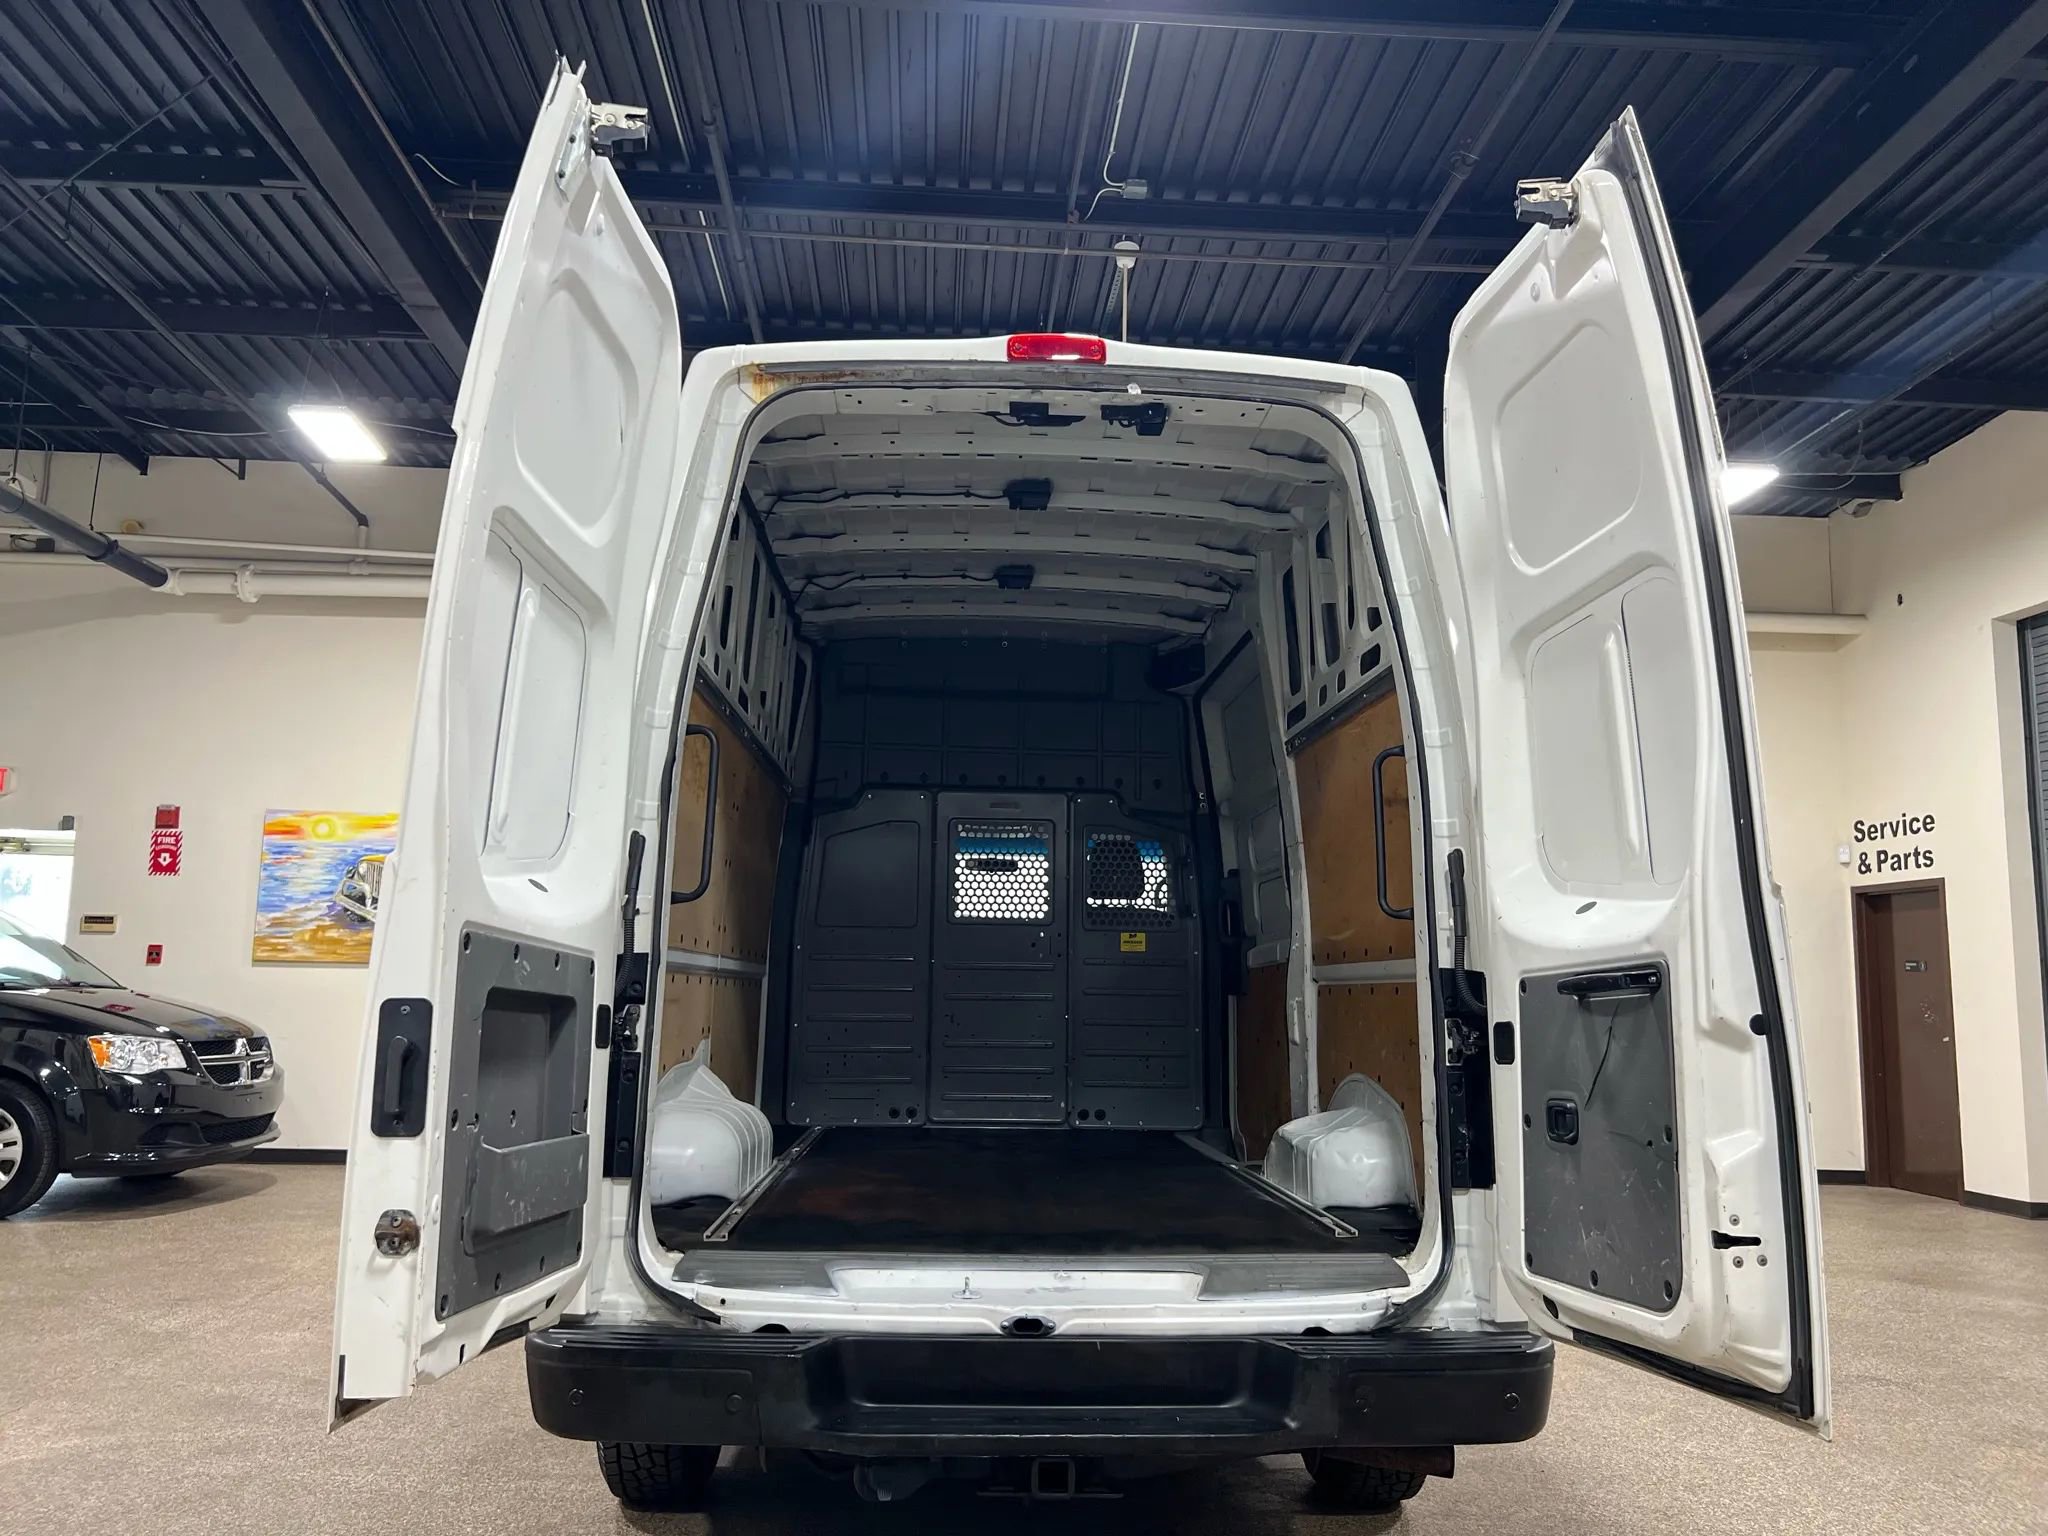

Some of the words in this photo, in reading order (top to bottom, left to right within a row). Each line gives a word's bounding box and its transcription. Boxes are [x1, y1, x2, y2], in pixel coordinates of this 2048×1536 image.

[157, 836, 177, 844] FIRE
[1853, 812, 1936, 843] Service
[1857, 851, 1872, 875] &
[1876, 845, 1934, 873] Parts
